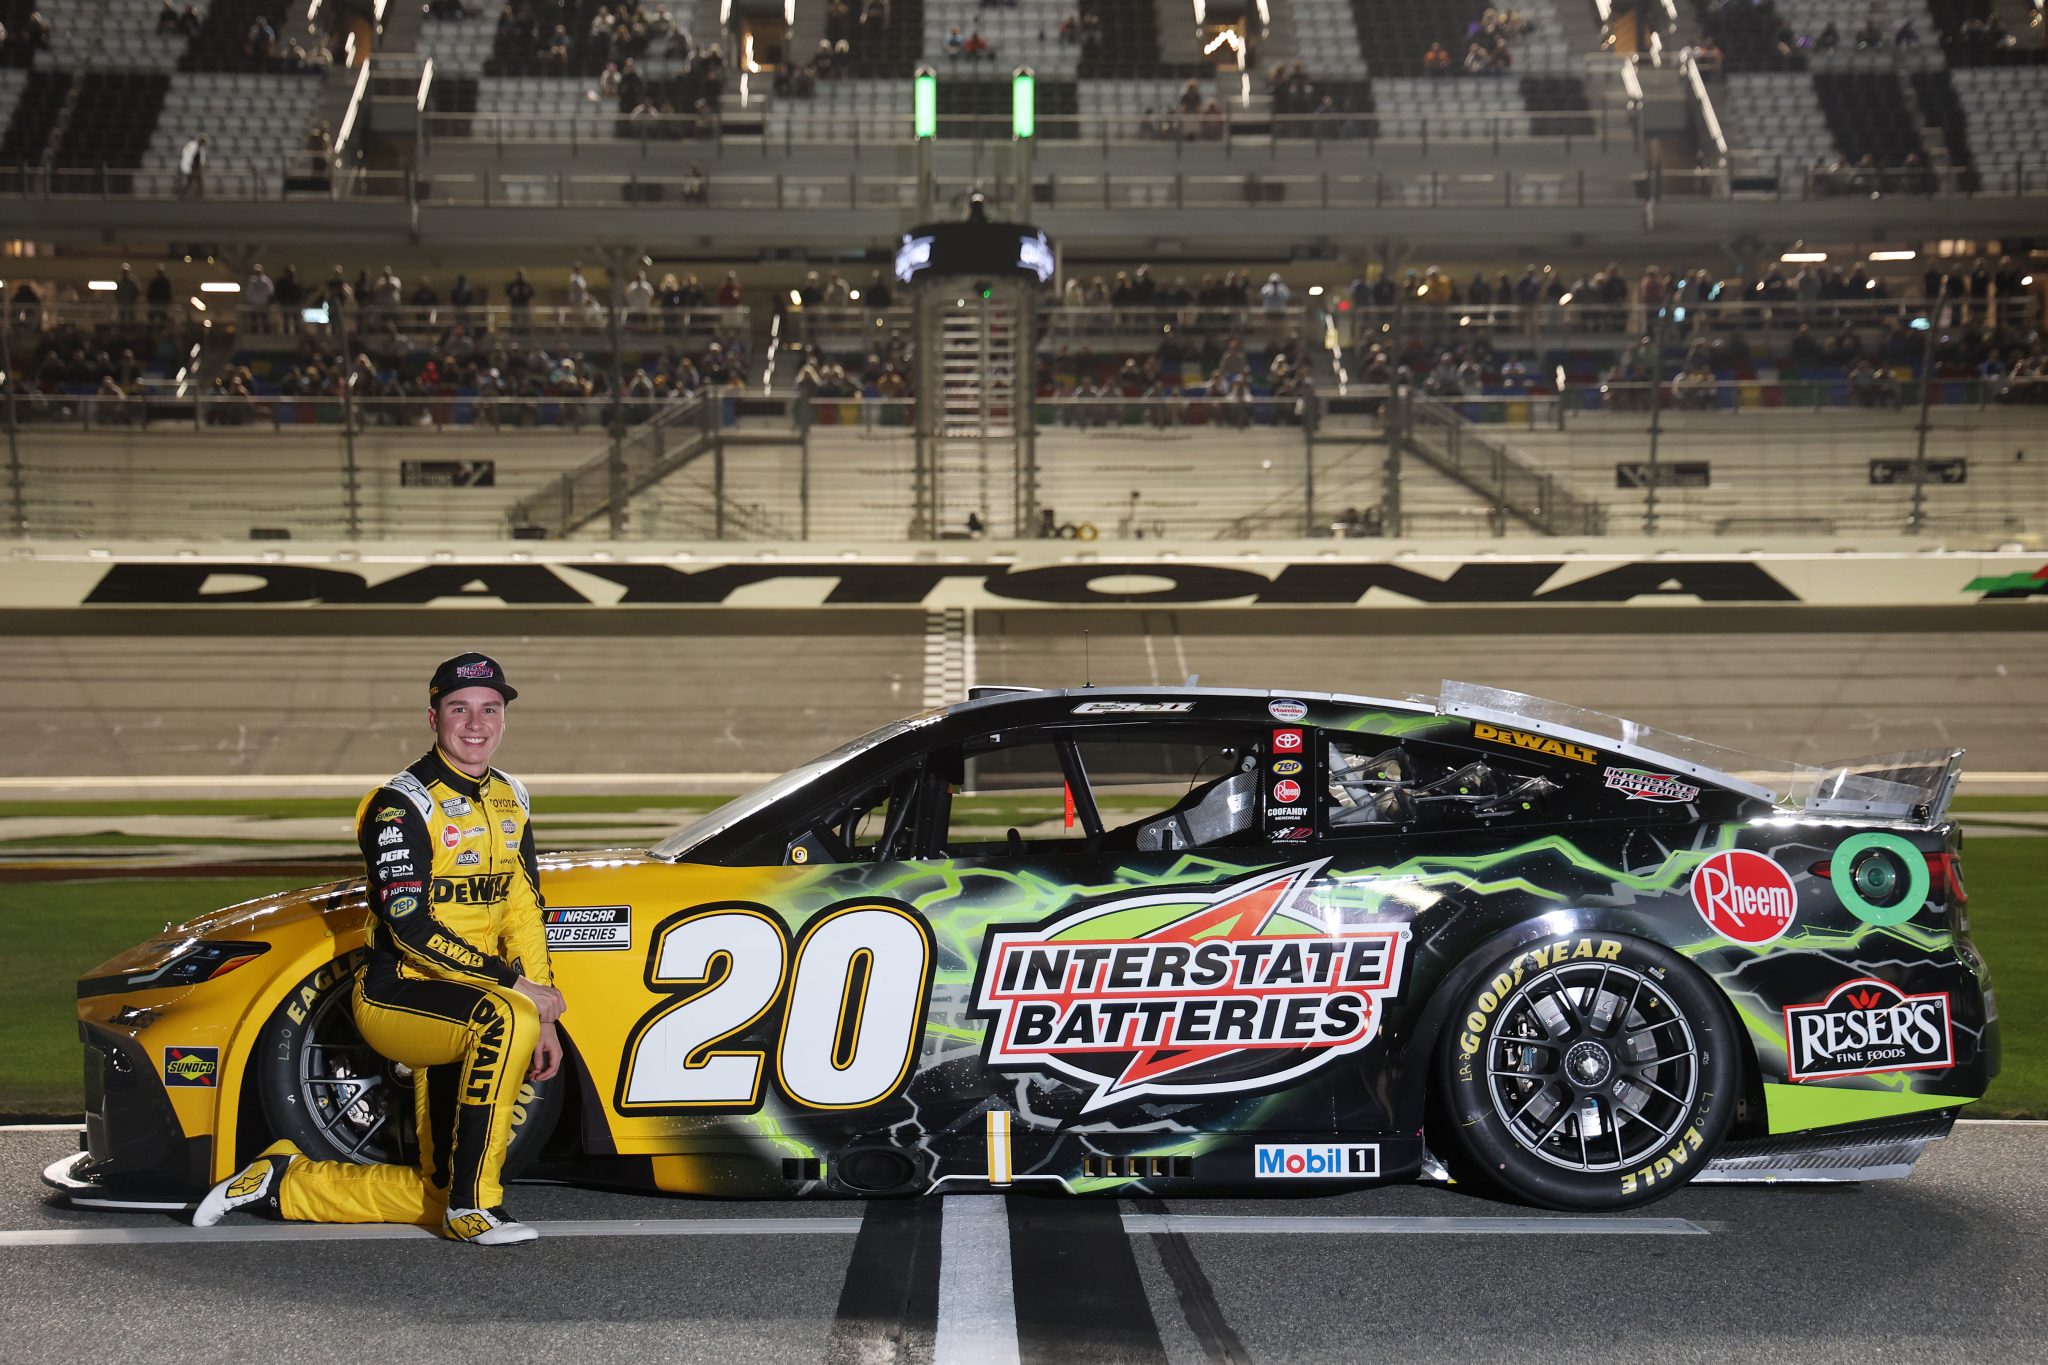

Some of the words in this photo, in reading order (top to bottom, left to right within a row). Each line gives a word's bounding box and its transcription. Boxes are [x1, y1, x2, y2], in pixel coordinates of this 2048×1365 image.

[81, 563, 1803, 604] DAYTONA
[1475, 722, 1597, 764] DEWALT
[1277, 781, 1299, 799] Rheem
[1609, 769, 1697, 793] INTERSTATE
[1611, 778, 1690, 799] BATTERIES
[376, 810, 405, 821] SUNOCO
[1267, 807, 1308, 817] COOFANDY
[378, 826, 403, 844] MAC
[380, 837, 403, 847] TOOLS
[376, 849, 410, 865] JGR
[391, 864, 414, 873] DN
[390, 886, 422, 896] AUCTION
[1702, 853, 1790, 928] Rheem
[564, 909, 616, 922] NASCAR
[547, 929, 571, 941] CUP
[573, 928, 617, 941] SERIES
[1001, 940, 1388, 992] INTERSTATE
[615, 898, 936, 1115] 20
[1013, 994, 1364, 1046] BATTERIES
[1798, 1001, 1942, 1070] RESER'S
[1836, 1052, 1863, 1064] FINE
[1867, 1048, 1906, 1060] FOODS
[169, 1062, 214, 1073] SUNOCO
[1259, 1148, 1341, 1174] Mobil
[1620, 1125, 1704, 1195] EAGLE
